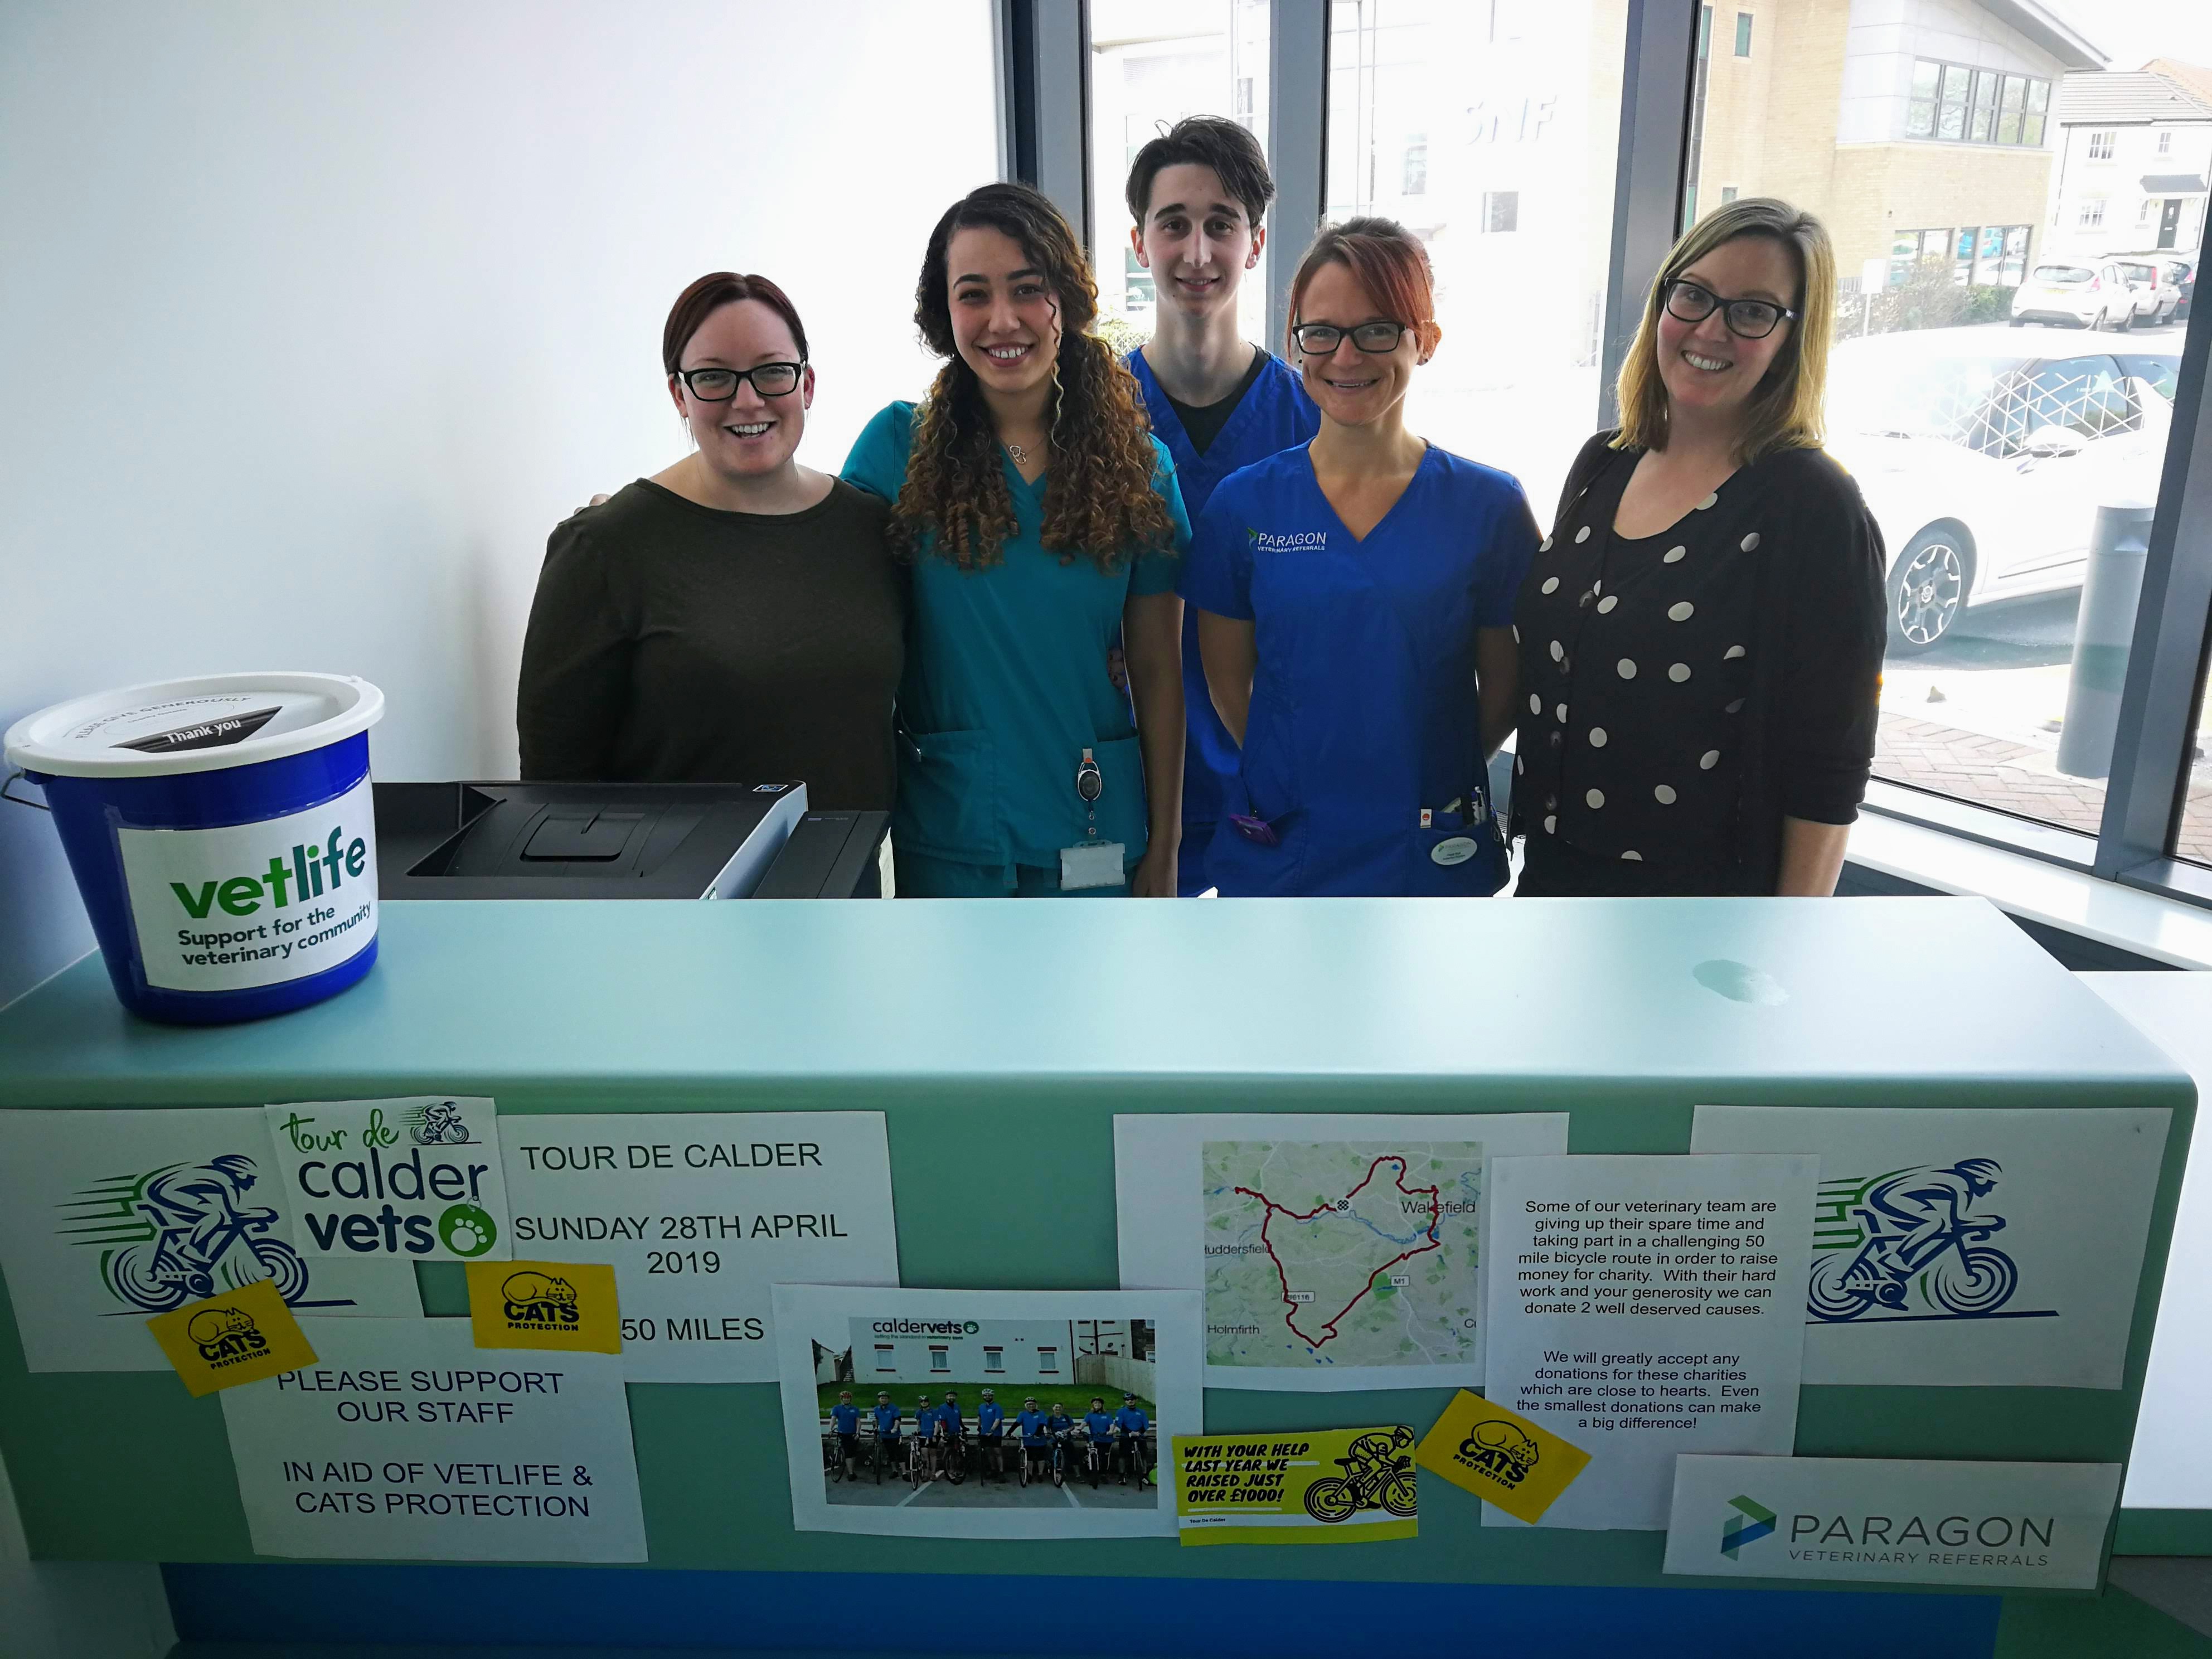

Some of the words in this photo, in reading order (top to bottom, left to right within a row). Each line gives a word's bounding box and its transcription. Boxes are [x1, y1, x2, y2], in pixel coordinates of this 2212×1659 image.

[1258, 532, 1326, 547] PARAGON
[139, 697, 251, 712] GENEROUSLY
[162, 726, 213, 744] Thank
[217, 719, 242, 736] you
[169, 826, 366, 919] vetlife
[178, 924, 268, 950] Support
[273, 918, 302, 935] for
[307, 906, 336, 928] the
[182, 943, 293, 966] veterinary
[298, 902, 372, 949] community
[280, 1113, 348, 1153] tour
[362, 1109, 399, 1148] de
[520, 1146, 617, 1170] TOUR
[628, 1145, 673, 1168] DE
[685, 1143, 822, 1168] CALDER
[297, 1146, 489, 1201] calder
[1401, 1201, 1475, 1213] Wakefield
[1526, 1201, 1570, 1212] Some
[1575, 1200, 1590, 1211] of
[1595, 1203, 1620, 1211] our
[1625, 1201, 1702, 1215] veterinary
[1707, 1201, 1745, 1211] team
[1752, 1203, 1776, 1211] are
[304, 1204, 435, 1254] vets
[516, 1217, 649, 1240] SUNDAY
[661, 1216, 741, 1239] 28TH
[751, 1214, 847, 1238] APRIL
[1535, 1218, 1579, 1232] giving
[1586, 1220, 1604, 1231] up
[1609, 1217, 1643, 1229] their
[1649, 1221, 1691, 1233] spare
[1697, 1217, 1730, 1229] time
[1735, 1217, 1764, 1229] and
[1534, 1235, 1578, 1249] taking
[1584, 1235, 1613, 1249] part
[1619, 1235, 1631, 1246] in
[1637, 1238, 1646, 1247] a
[1652, 1235, 1739, 1250] challenging
[1745, 1235, 1764, 1246] 50
[647, 1251, 720, 1273] 2019
[1519, 1252, 1549, 1263] mile
[1555, 1251, 1606, 1265] bicycle
[1613, 1254, 1651, 1264] route
[1657, 1253, 1669, 1264] in
[1675, 1253, 1716, 1264] order
[1721, 1253, 1734, 1264] to
[1740, 1253, 1777, 1264] raise
[1519, 1271, 1569, 1282] money
[1574, 1268, 1594, 1279] for
[1599, 1269, 1652, 1284] charity.
[1663, 1270, 1697, 1281] With
[1703, 1270, 1737, 1281] their
[1742, 1269, 1776, 1281] hard
[1520, 1285, 1555, 1297] work
[1561, 1285, 1588, 1296] and
[1594, 1288, 1628, 1299] your
[1633, 1287, 1713, 1301] generosity
[1718, 1289, 1739, 1298] we
[1745, 1289, 1771, 1297] can
[503, 1301, 580, 1323] CATS
[1525, 1302, 1576, 1313] donate
[1581, 1302, 1590, 1313] 2
[1595, 1302, 1624, 1314] well
[1631, 1303, 1700, 1314] deserved
[1706, 1306, 1764, 1314] causes.
[507, 1321, 579, 1332] PROTECTION
[622, 1319, 655, 1340] 50
[667, 1318, 764, 1340] MILES
[873, 1318, 962, 1334] caldervets
[1207, 1325, 1260, 1334] Holmfirth
[198, 1328, 268, 1362] CATS
[210, 1348, 271, 1370] PROTECTION
[1544, 1351, 1568, 1362] We
[1573, 1352, 1596, 1363] will
[1602, 1352, 1652, 1366] greatly
[1658, 1354, 1708, 1366] accept
[1713, 1356, 1739, 1366] any
[1535, 1367, 1608, 1380] donations
[1613, 1369, 1633, 1380] for
[1638, 1369, 1678, 1380] these
[1684, 1369, 1746, 1380] charities
[278, 1371, 401, 1391] PLEASE
[411, 1371, 561, 1394] SUPPORT
[1521, 1384, 1562, 1394] which
[1568, 1387, 1592, 1395] are
[1598, 1385, 1636, 1396] close
[1641, 1386, 1655, 1396] to
[1661, 1385, 1710, 1396] hearts.
[1722, 1385, 1759, 1396] Even
[337, 1401, 409, 1422] OUR
[418, 1402, 513, 1423] STAFF
[1517, 1400, 1539, 1410] the
[1545, 1400, 1605, 1412] smallest
[1611, 1401, 1683, 1412] donations
[1689, 1404, 1715, 1413] can
[1721, 1401, 1760, 1412] make
[1593, 1417, 1614, 1430] big
[1619, 1417, 1696, 1428] difference!
[1185, 1445, 1223, 1458] WITH
[1227, 1444, 1267, 1457] YOUR
[1271, 1443, 1309, 1456] HELP
[1185, 1460, 1221, 1472] LAST
[1225, 1459, 1262, 1472] YEAR
[1267, 1459, 1289, 1471] WE
[1458, 1437, 1531, 1484] CATS
[283, 1462, 314, 1481] IN
[323, 1462, 372, 1482] AID
[384, 1463, 423, 1483] OF
[434, 1463, 562, 1485] VETLIFE
[573, 1466, 593, 1486] &
[1186, 1474, 1240, 1487] RAISED
[1244, 1474, 1284, 1487] JUST
[1453, 1454, 1516, 1491] PROTECTION
[1188, 1490, 1226, 1502] OVER
[1230, 1488, 1284, 1502] £1000!
[296, 1492, 375, 1513] CATS
[385, 1493, 589, 1516] PROTECTION
[1791, 1514, 2055, 1548] PARAGON
[1789, 1549, 1919, 1564] VETERINARY
[1928, 1553, 2048, 1568] REFERRALS
